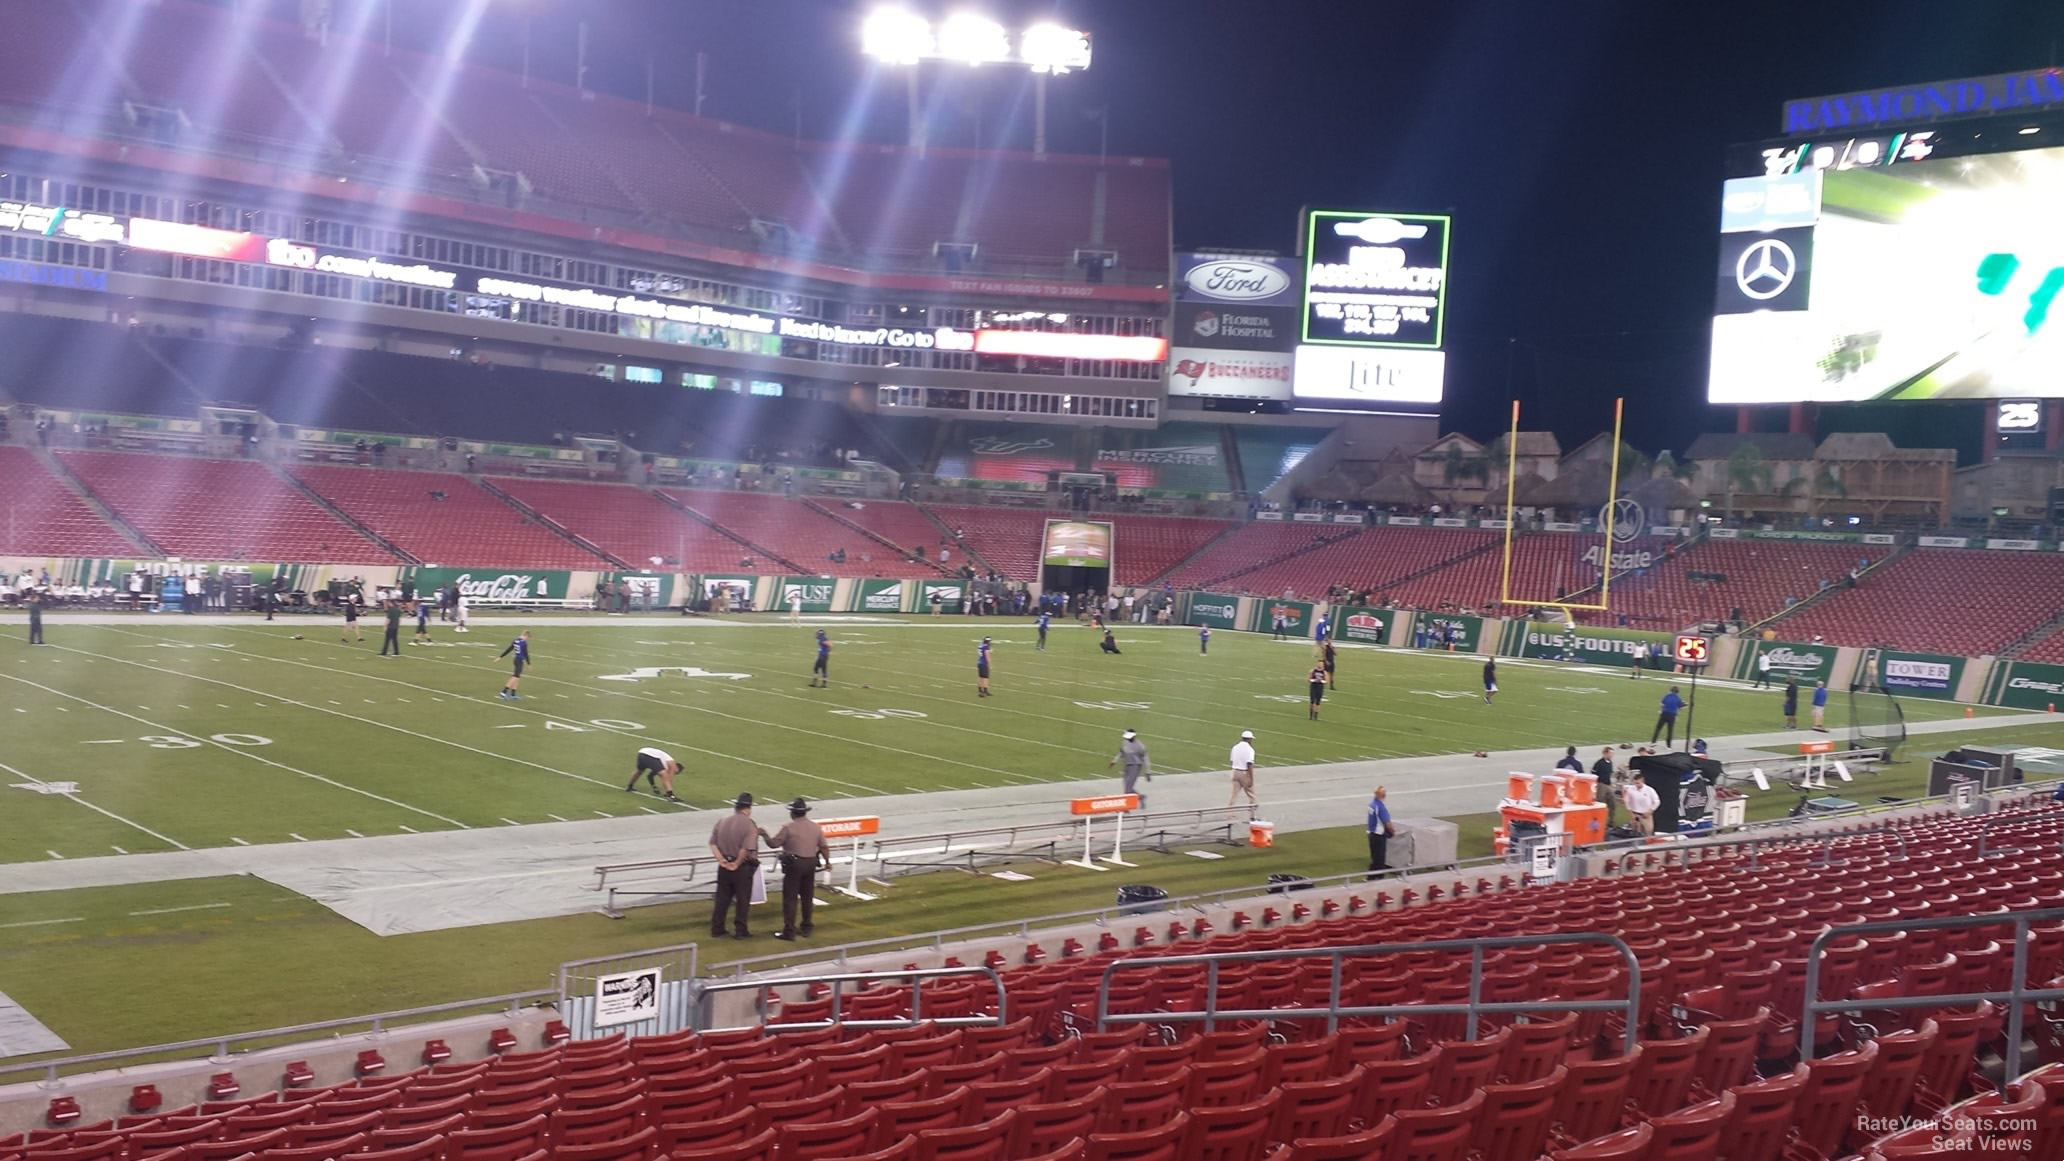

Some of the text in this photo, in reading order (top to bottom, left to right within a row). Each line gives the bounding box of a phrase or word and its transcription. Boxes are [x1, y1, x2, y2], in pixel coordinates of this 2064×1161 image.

[1786, 82, 1986, 134] RAYMOND
[951, 280, 977, 291] TEXT
[979, 282, 1002, 291] FAN
[1206, 266, 1268, 293] Ford
[1221, 313, 1271, 327] FLORIDA
[887, 328, 915, 347] Go
[914, 331, 935, 348] to
[1221, 325, 1275, 339] HOSPITAL
[1207, 361, 1291, 383] BUCCANEERS
[1999, 403, 2039, 427] 25
[1097, 449, 1217, 461] MERCURY
[1097, 455, 1219, 467] INSURANCE
[801, 585, 833, 600] USF
[1679, 638, 1705, 659] 25
[1887, 663, 1948, 677] TOWER
[1886, 677, 1920, 687] Radiology
[545, 718, 647, 732] 40
[138, 733, 274, 748] 30
